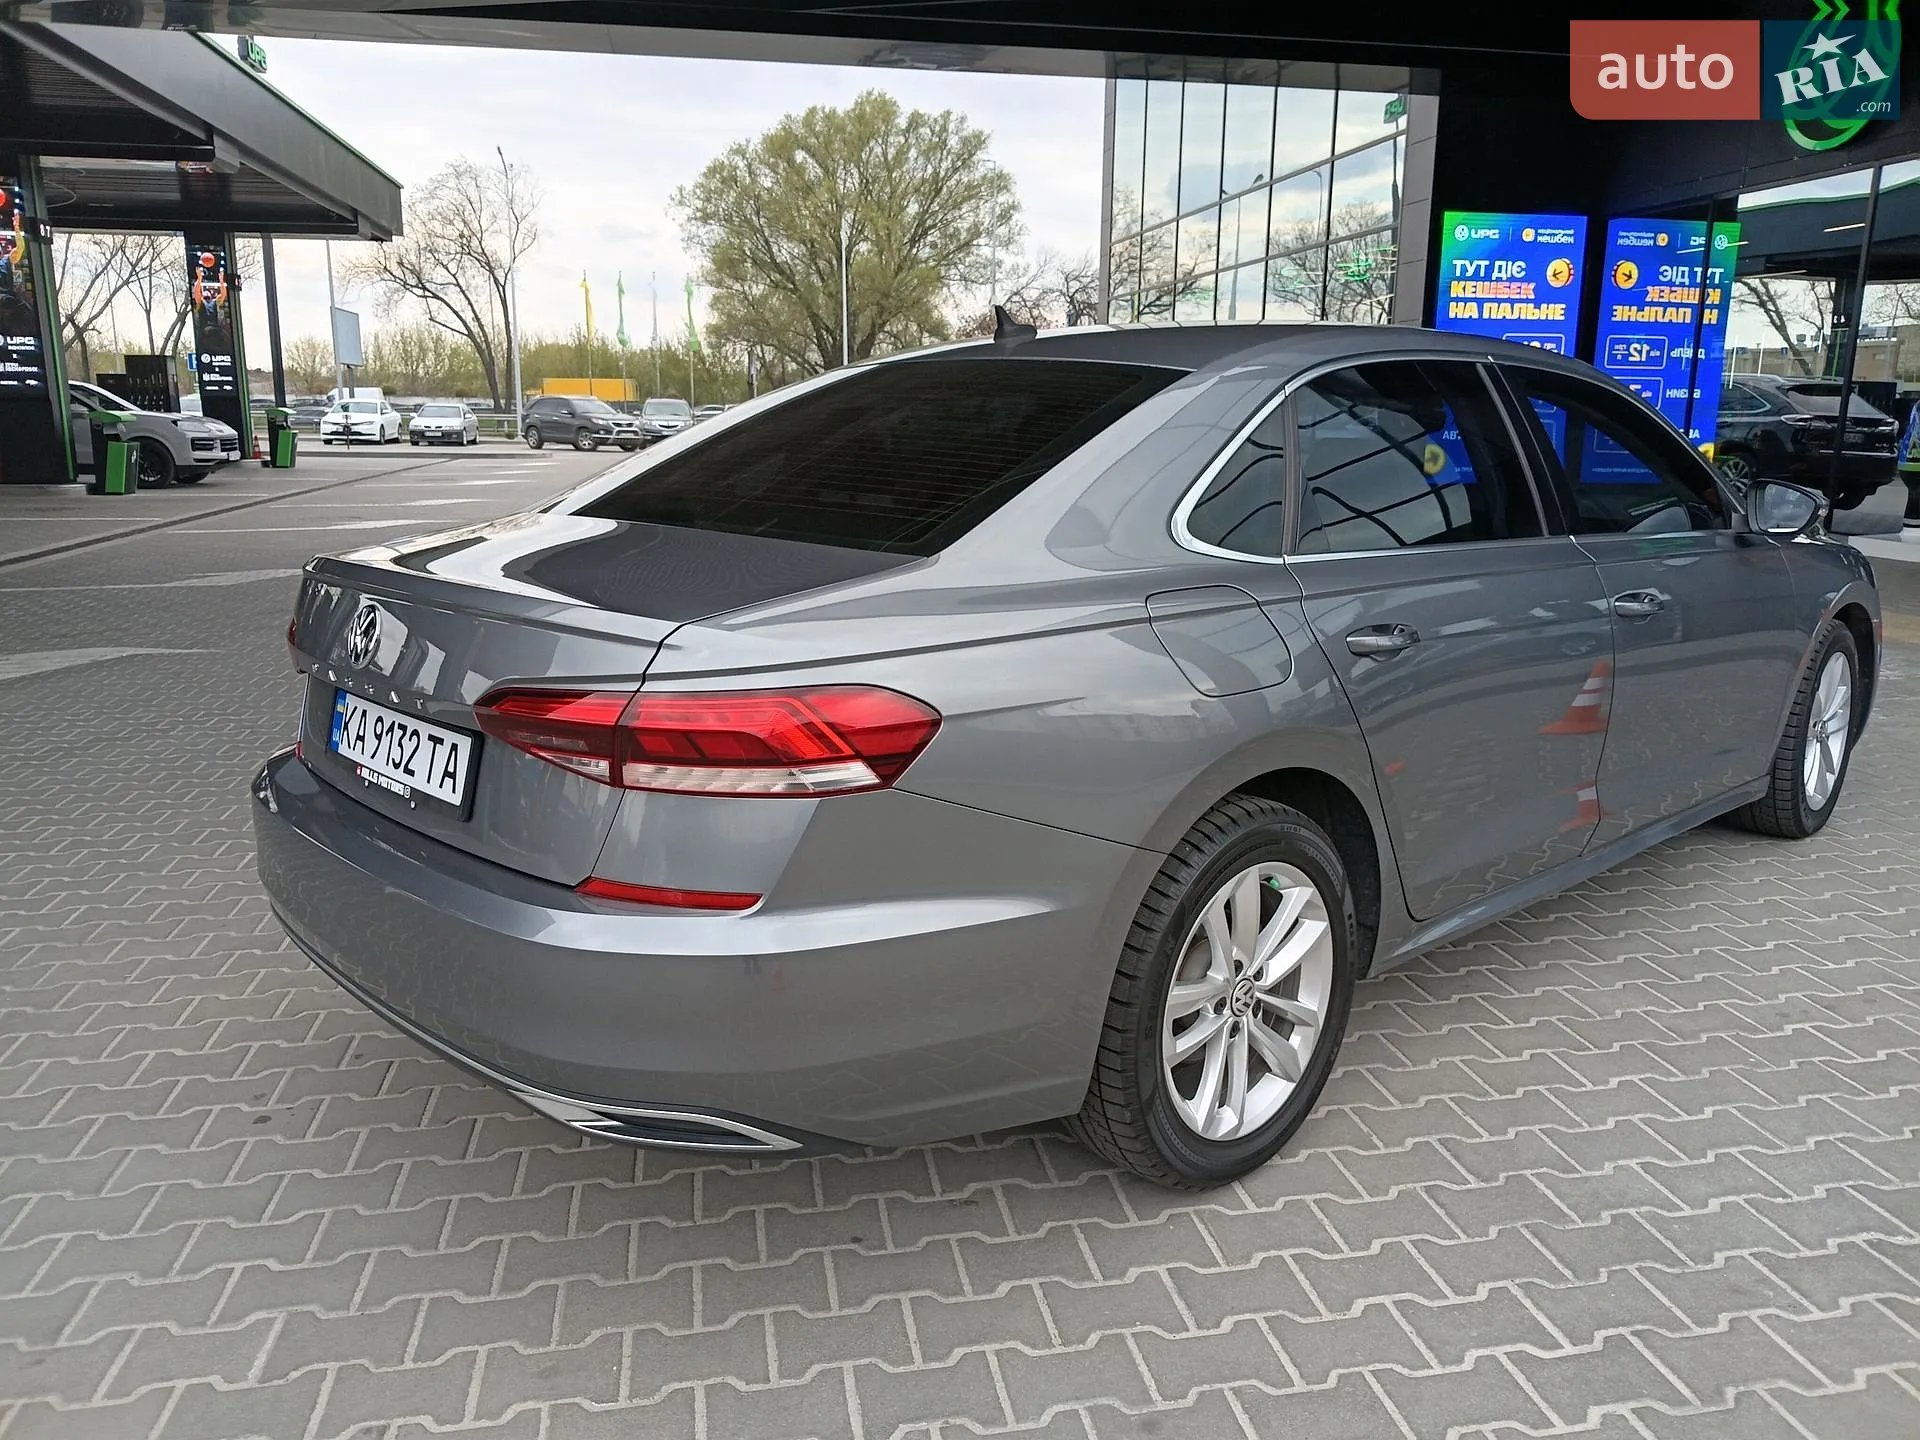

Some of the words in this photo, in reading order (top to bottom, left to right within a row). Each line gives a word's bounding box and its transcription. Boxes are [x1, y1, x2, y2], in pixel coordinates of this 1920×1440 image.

[1471, 228, 1500, 239] UPG
[1453, 259, 1490, 277] ТУТ
[1491, 260, 1527, 280] ДІЄ
[1450, 281, 1536, 299] КЕШБЕК
[1449, 302, 1479, 319] НА
[1482, 302, 1567, 320] ПАЛЬНЕ
[6, 336, 35, 345] UPG
[341, 703, 368, 755] KA
[370, 716, 421, 777] 9132
[427, 733, 459, 794] TA
